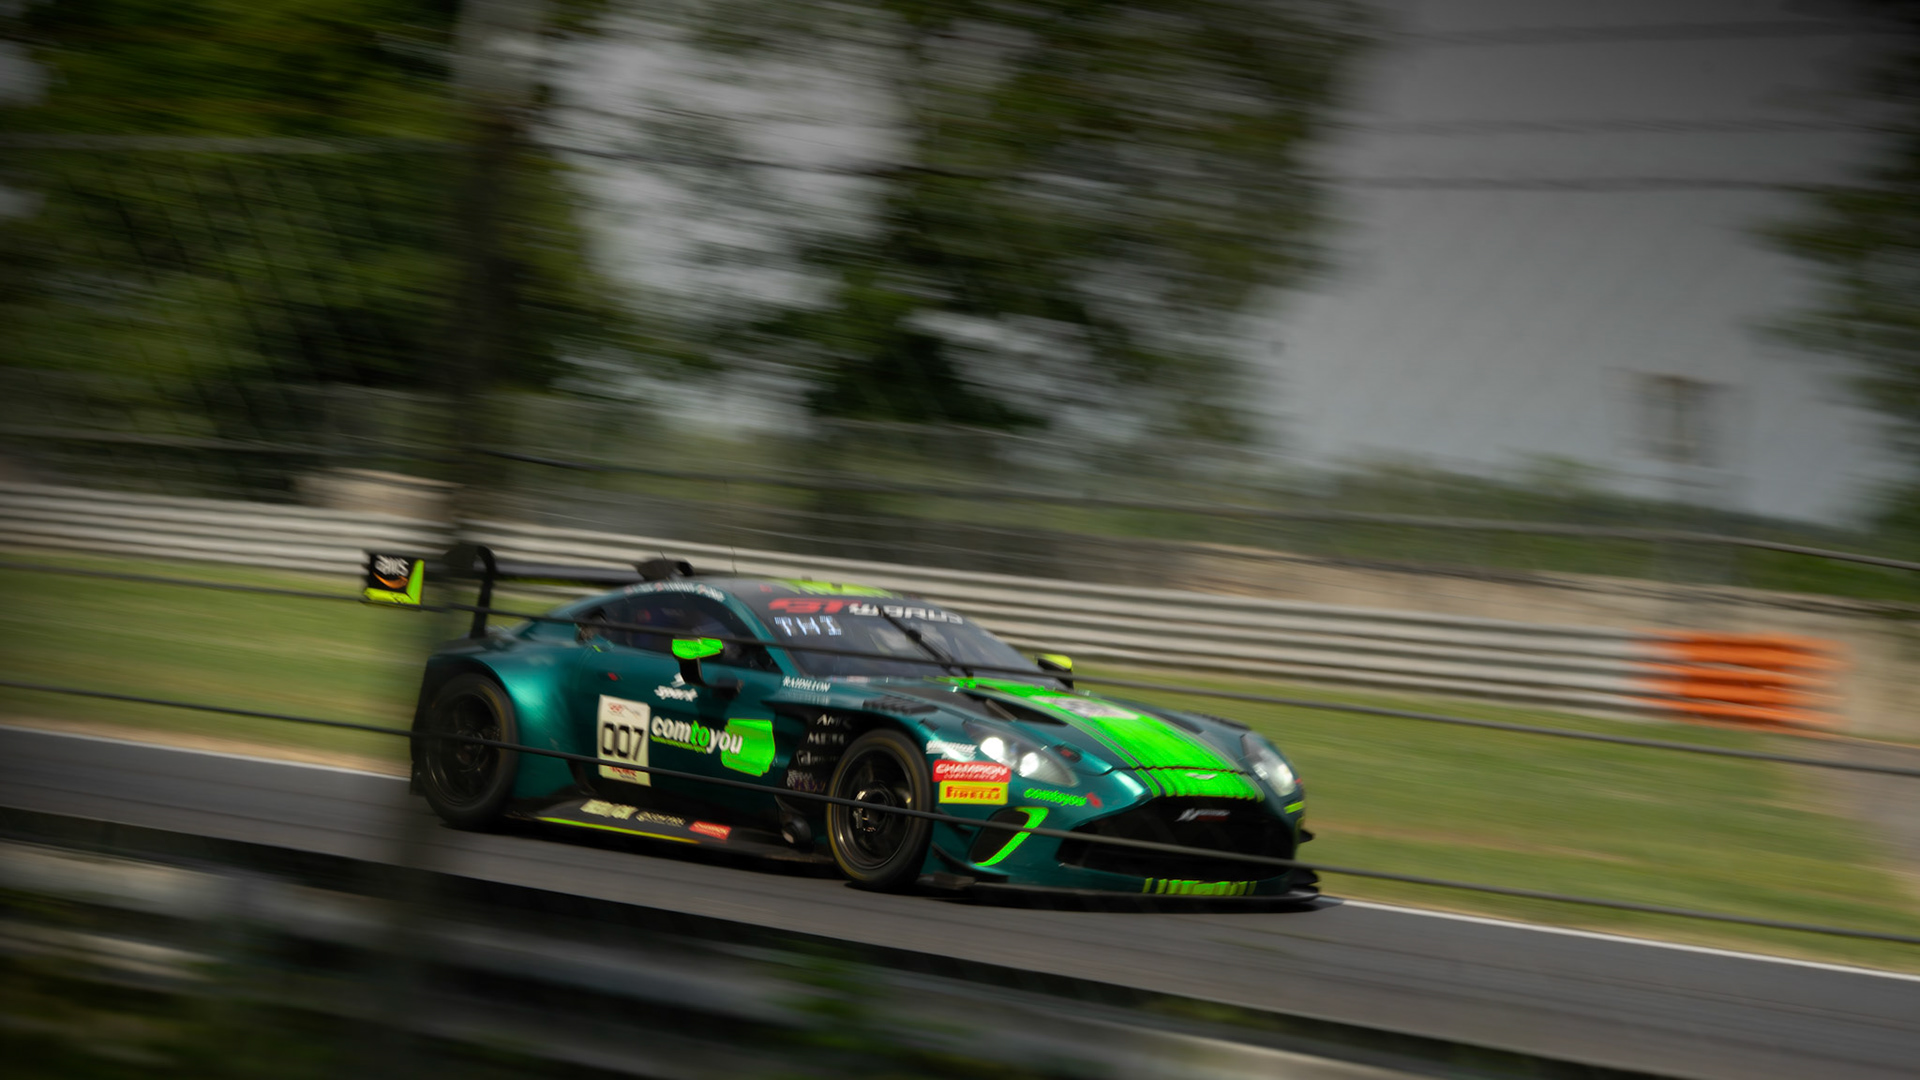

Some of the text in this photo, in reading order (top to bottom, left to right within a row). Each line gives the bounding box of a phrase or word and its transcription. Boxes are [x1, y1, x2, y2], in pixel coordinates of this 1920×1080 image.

[602, 722, 644, 761] 007
[651, 716, 743, 754] comtoyou
[936, 763, 1008, 776] CHAMPION
